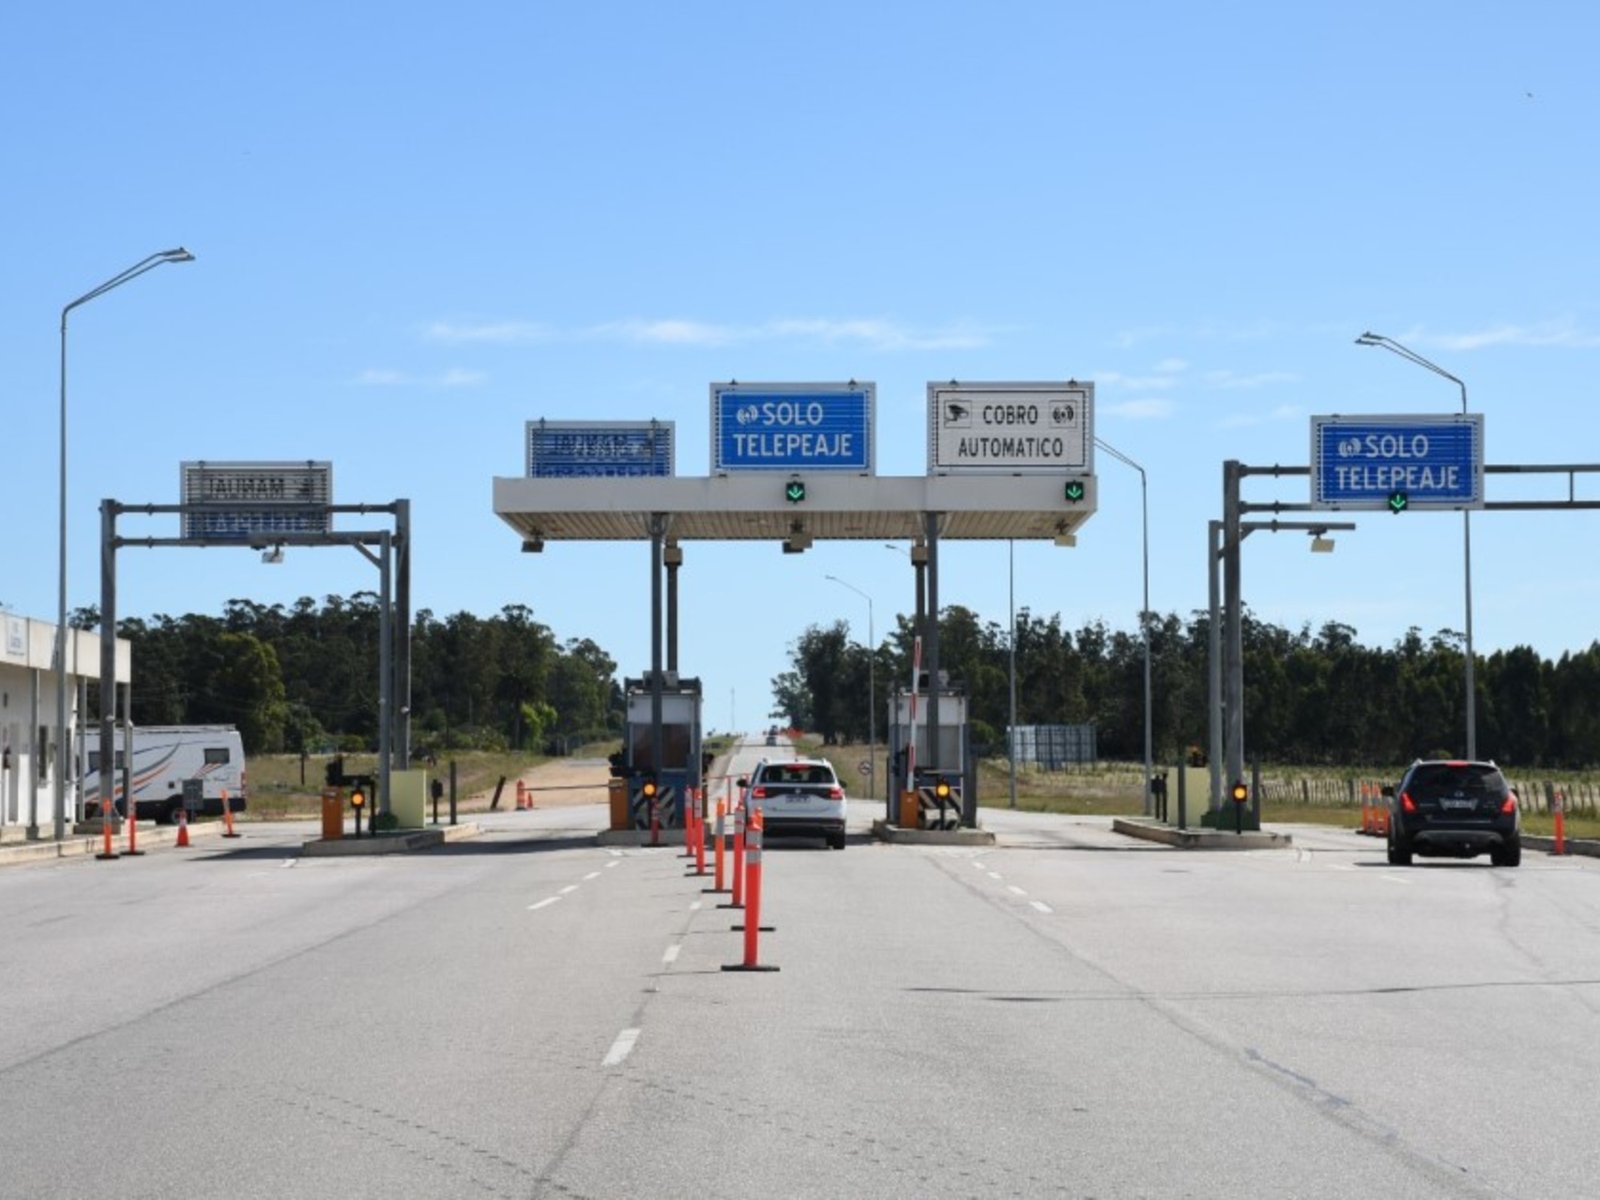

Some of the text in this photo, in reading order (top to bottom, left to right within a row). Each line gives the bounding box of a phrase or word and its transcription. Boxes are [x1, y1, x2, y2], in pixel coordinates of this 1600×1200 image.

[762, 402, 823, 426] SOLO
[983, 404, 1038, 425] COBRO
[733, 433, 853, 457] TELEPEAJE
[958, 437, 1063, 458] AUTOMATICO
[1365, 434, 1429, 458] SOLO
[1334, 466, 1459, 490] TELEPEAJE
